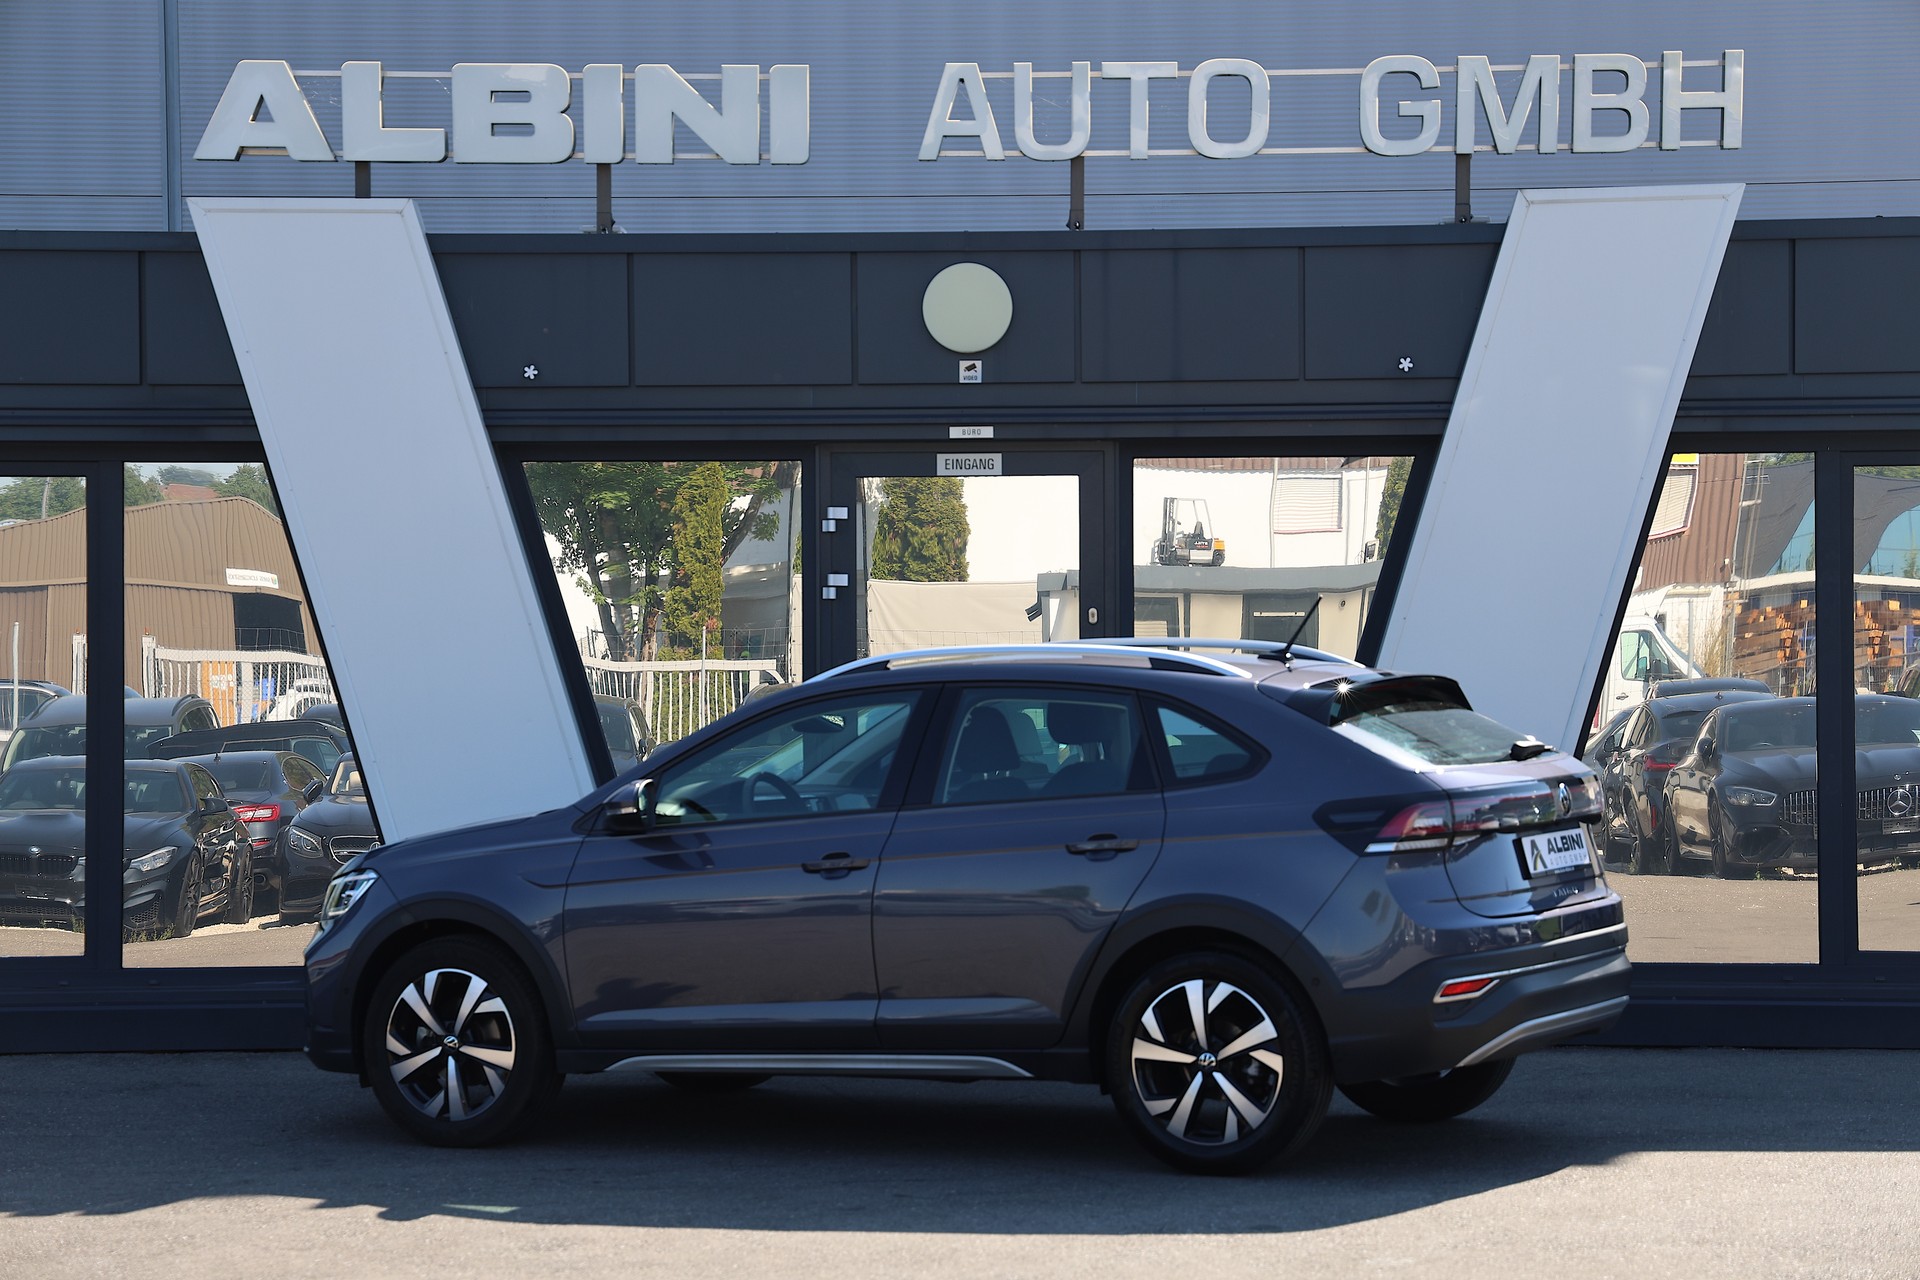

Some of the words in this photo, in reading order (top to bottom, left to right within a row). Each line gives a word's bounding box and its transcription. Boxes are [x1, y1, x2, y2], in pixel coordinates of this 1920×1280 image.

[193, 59, 811, 165] ALBINI
[917, 59, 1270, 163] AUTO
[1358, 48, 1744, 157] GMBH
[944, 457, 995, 470] EINGANG
[1547, 833, 1585, 855] ALBINI
